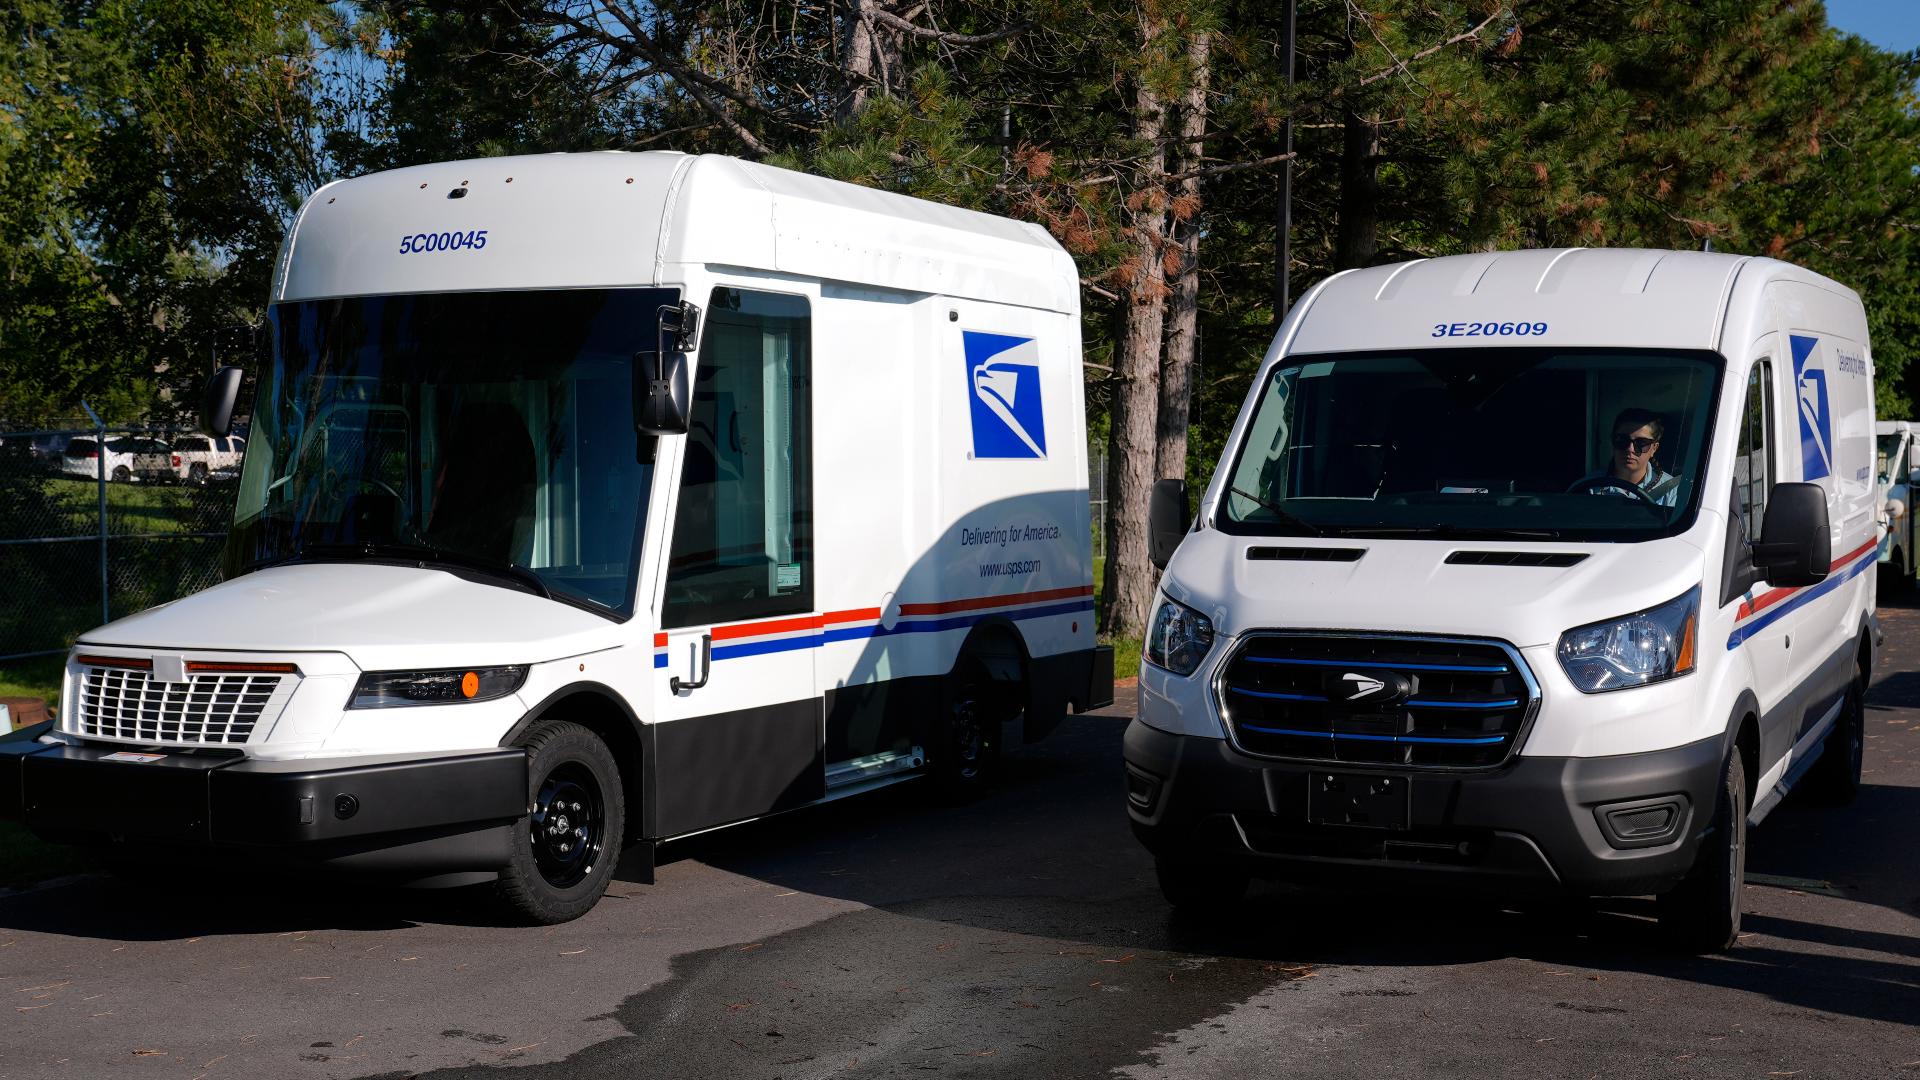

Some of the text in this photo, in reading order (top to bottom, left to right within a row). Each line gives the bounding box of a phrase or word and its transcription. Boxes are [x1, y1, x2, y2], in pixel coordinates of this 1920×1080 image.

[399, 230, 489, 255] 5C00045
[1431, 322, 1548, 338] 3E20609
[961, 526, 1008, 547] Delivering
[1009, 525, 1022, 542] for
[980, 559, 1041, 578] www.usps.com
